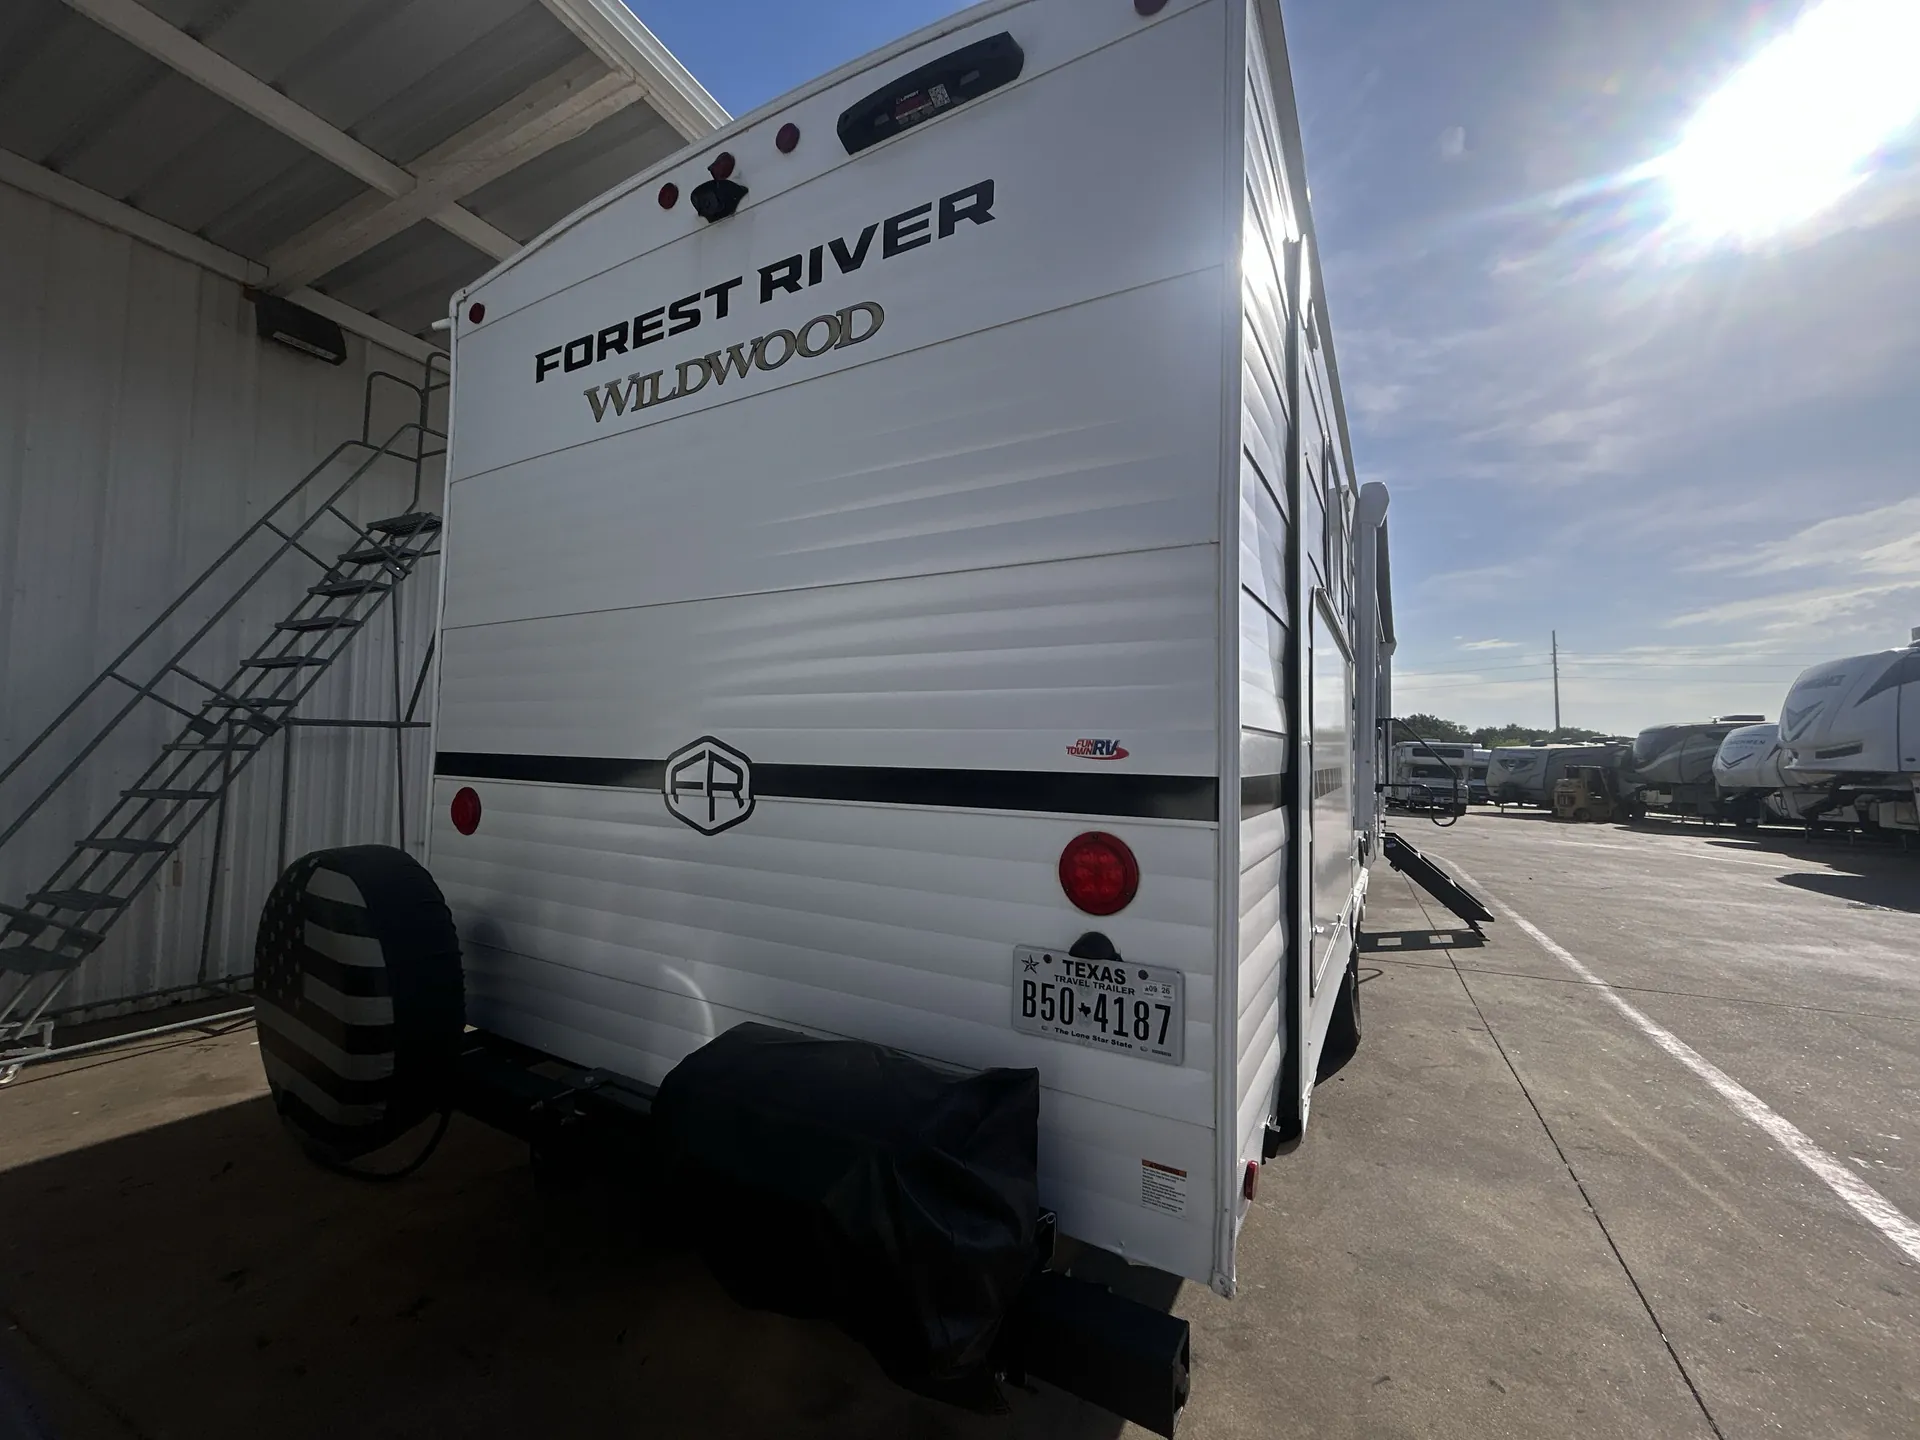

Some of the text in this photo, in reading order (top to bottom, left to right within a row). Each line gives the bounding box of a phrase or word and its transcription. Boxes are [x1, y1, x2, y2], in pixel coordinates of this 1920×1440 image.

[535, 179, 996, 383] FOREST RIVER
[583, 301, 885, 423] WILDWOOD
[1066, 746, 1093, 755] TOWN
[1076, 739, 1093, 748] FUN
[1092, 739, 1120, 755] RV
[1062, 959, 1126, 985] TEXAS
[1054, 974, 1135, 996] TRAVEL TRAILER
[1054, 1027, 1133, 1049] The Lone Star State
